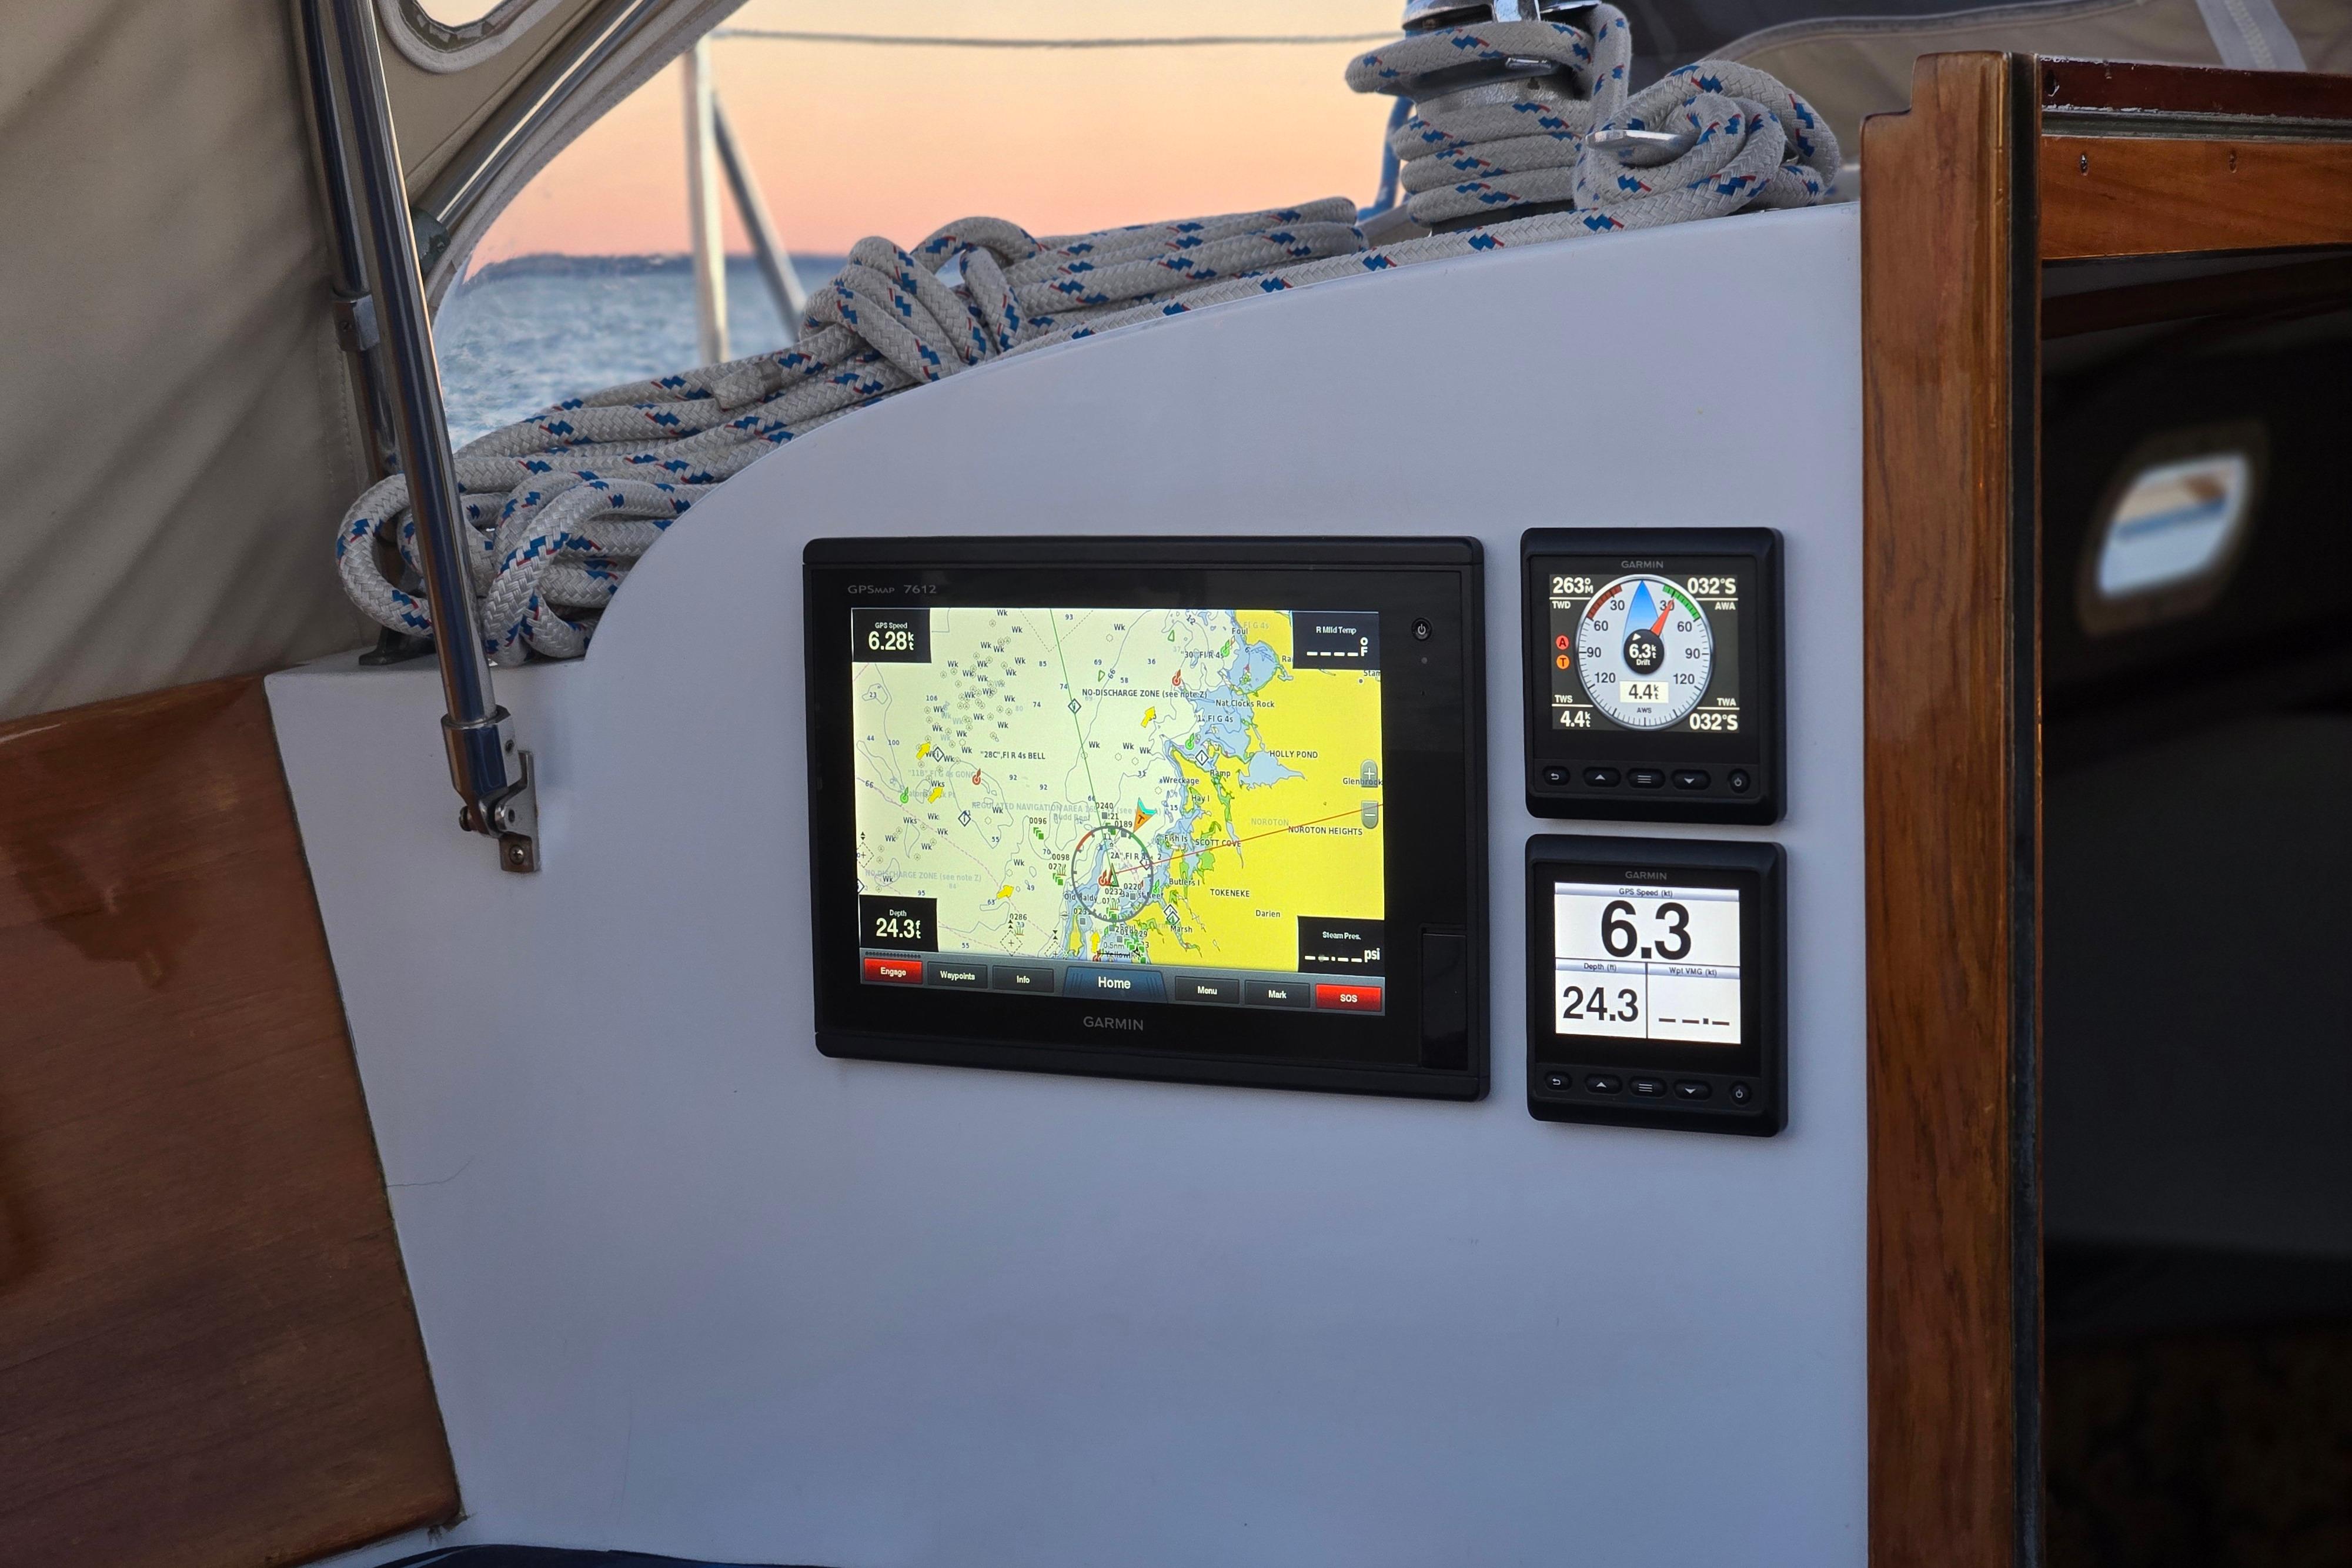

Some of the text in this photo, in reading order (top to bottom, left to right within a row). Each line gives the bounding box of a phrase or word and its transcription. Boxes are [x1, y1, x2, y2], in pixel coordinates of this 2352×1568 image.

[904, 585, 936, 594] 7612
[1611, 600, 1625, 610] 30
[1660, 600, 1674, 611] 30
[1187, 615, 1195, 625] 12
[1594, 621, 1608, 631] 60
[1678, 621, 1692, 631] 60
[1559, 638, 1566, 647] A
[1587, 647, 1601, 657] 90
[1685, 648, 1700, 658] 90
[1560, 658, 1566, 667] T
[1595, 673, 1615, 683] 120
[1673, 674, 1695, 684] 120
[1717, 698, 1736, 706] TWA
[1343, 777, 1382, 785] Glenbrook
[1191, 795, 1206, 803] Hay
[1329, 827, 1363, 835] HEIGHTS
[1625, 871, 1667, 880] GARMIN
[1210, 889, 1250, 897] TOKENEKE
[1601, 900, 1691, 960] 6.3
[1365, 948, 1380, 962] psi
[881, 968, 906, 977] Engage
[1607, 964, 1616, 972] (ft)
[940, 971, 975, 981] Waypoints
[1098, 977, 1130, 988] Home
[1198, 987, 1217, 995] Menu
[1269, 990, 1287, 998] Mark
[1340, 994, 1357, 1002] SOS
[1563, 986, 1638, 1022] 24.3
[1083, 1017, 1143, 1030] GARMIN
